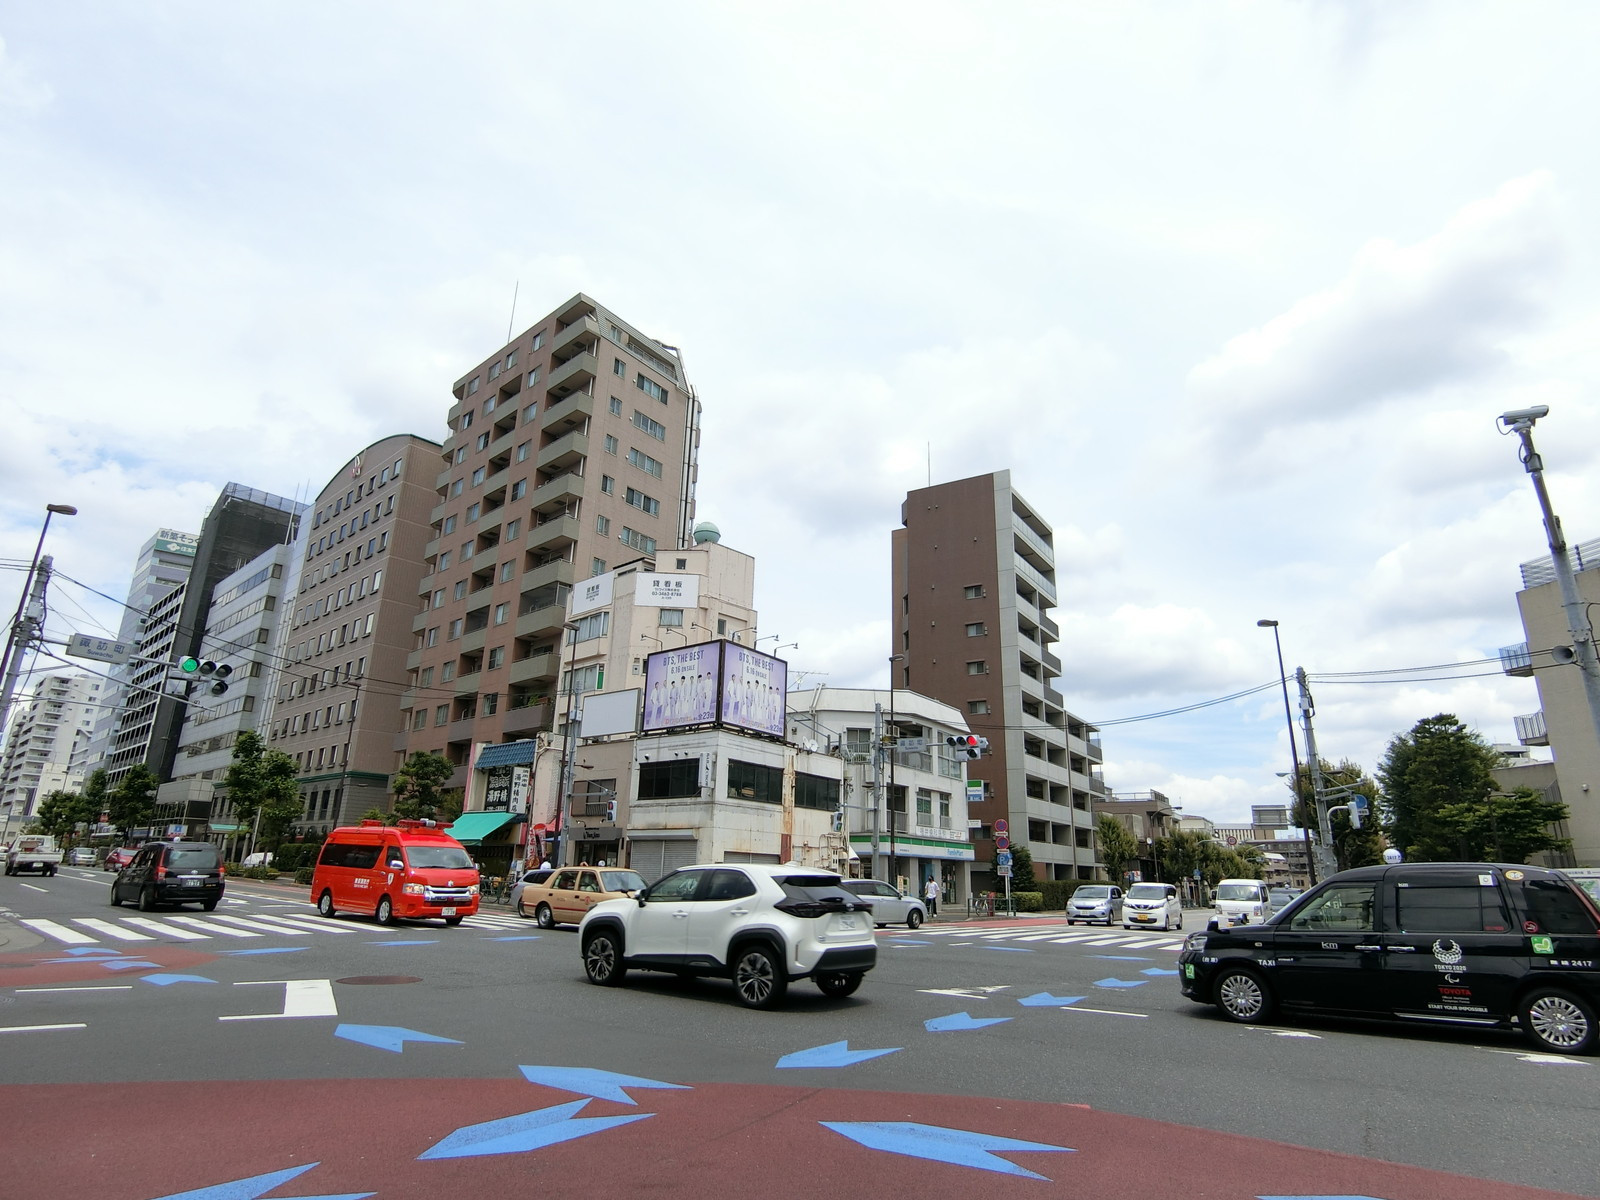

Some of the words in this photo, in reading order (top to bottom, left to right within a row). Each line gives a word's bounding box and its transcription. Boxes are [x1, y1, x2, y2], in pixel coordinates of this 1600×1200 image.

[662, 656, 676, 667] BTS,
[677, 653, 688, 664] THE
[689, 649, 705, 661] BEST
[738, 652, 751, 665] BTS,
[751, 656, 761, 669] THE
[762, 660, 775, 672] BEST
[1321, 941, 1339, 950] km
[1257, 958, 1276, 967] TAXI
[1438, 988, 1472, 996] TOYOTA
